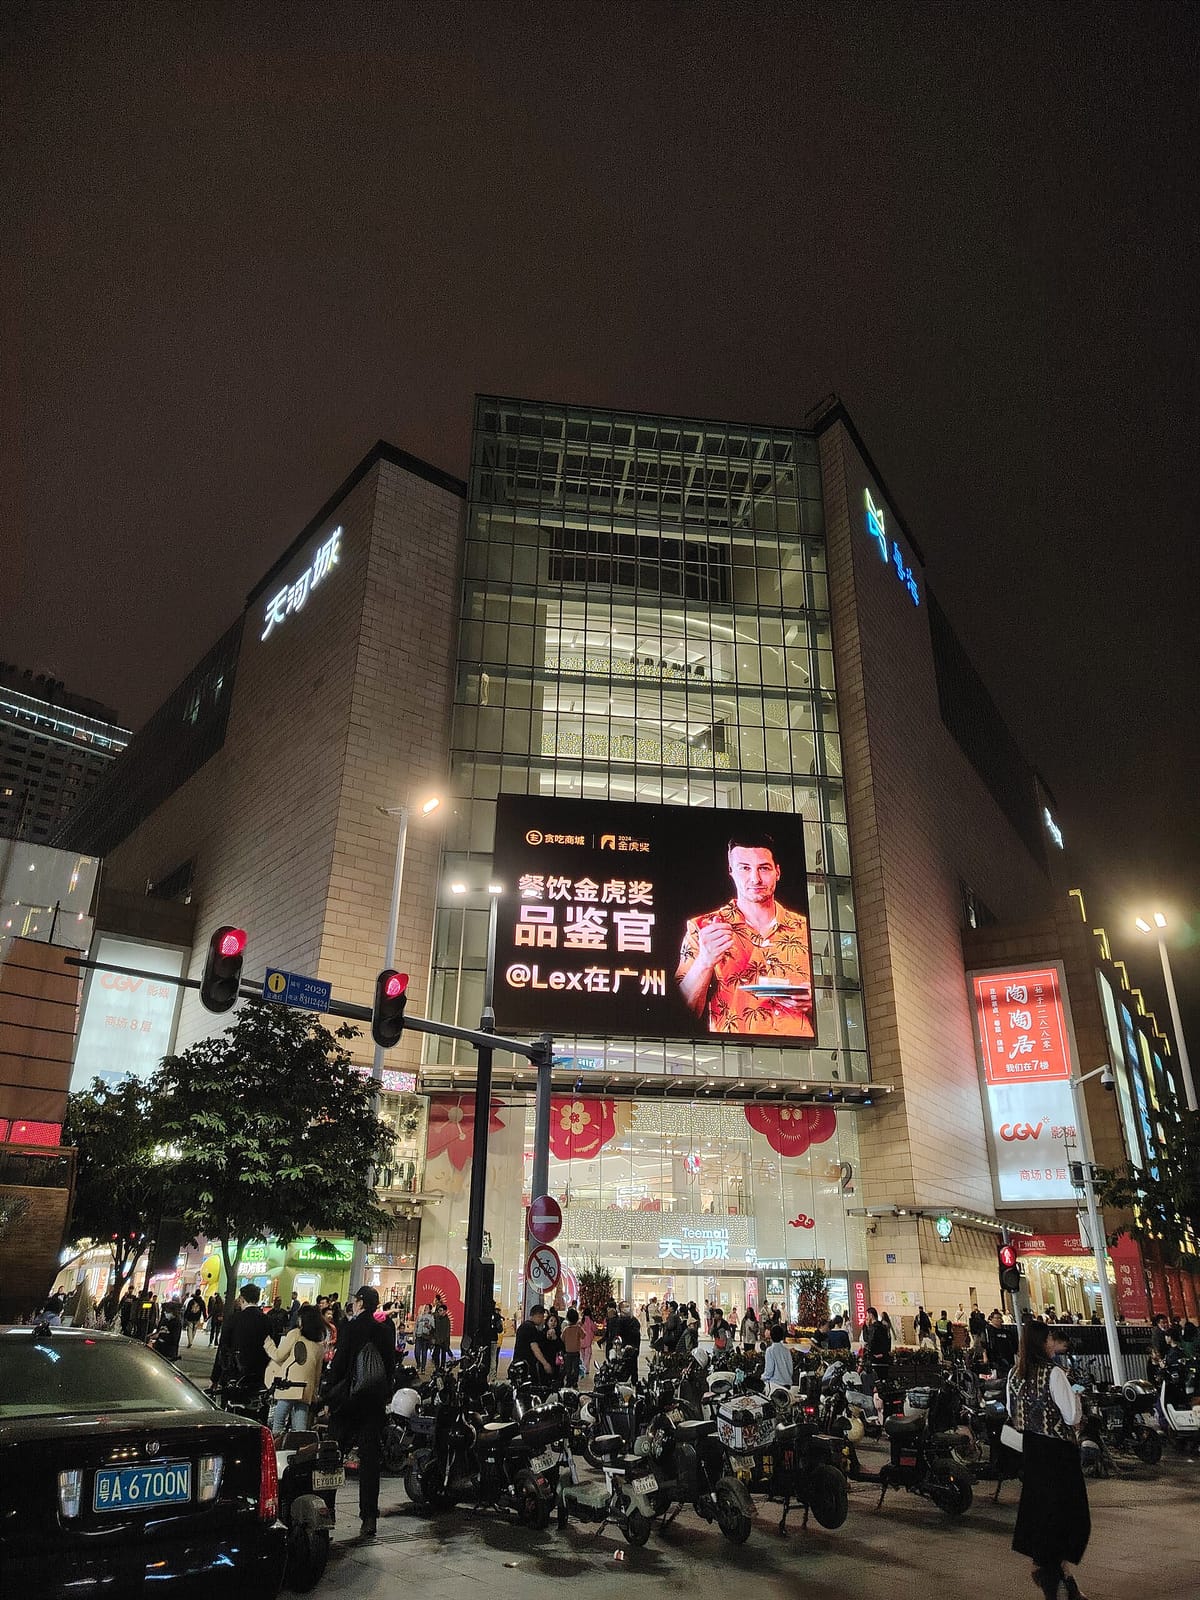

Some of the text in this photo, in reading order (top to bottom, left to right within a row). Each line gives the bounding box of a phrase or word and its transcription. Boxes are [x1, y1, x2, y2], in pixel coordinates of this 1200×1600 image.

[261, 525, 342, 641] 天河城
[544, 833, 585, 846] 贪吃商城
[618, 841, 650, 852] 金虎奖
[518, 874, 653, 906] 餐饮金虎奖
[514, 905, 656, 953] 品鉴官
[100, 973, 144, 993] CGV
[304, 983, 327, 997] 2029
[505, 963, 667, 997] @Lex在广州
[1005, 984, 1037, 1060] 陶陶居
[1000, 1122, 1044, 1142] CGV
[681, 1227, 729, 1240] Teemall
[658, 1238, 730, 1265] 天河城
